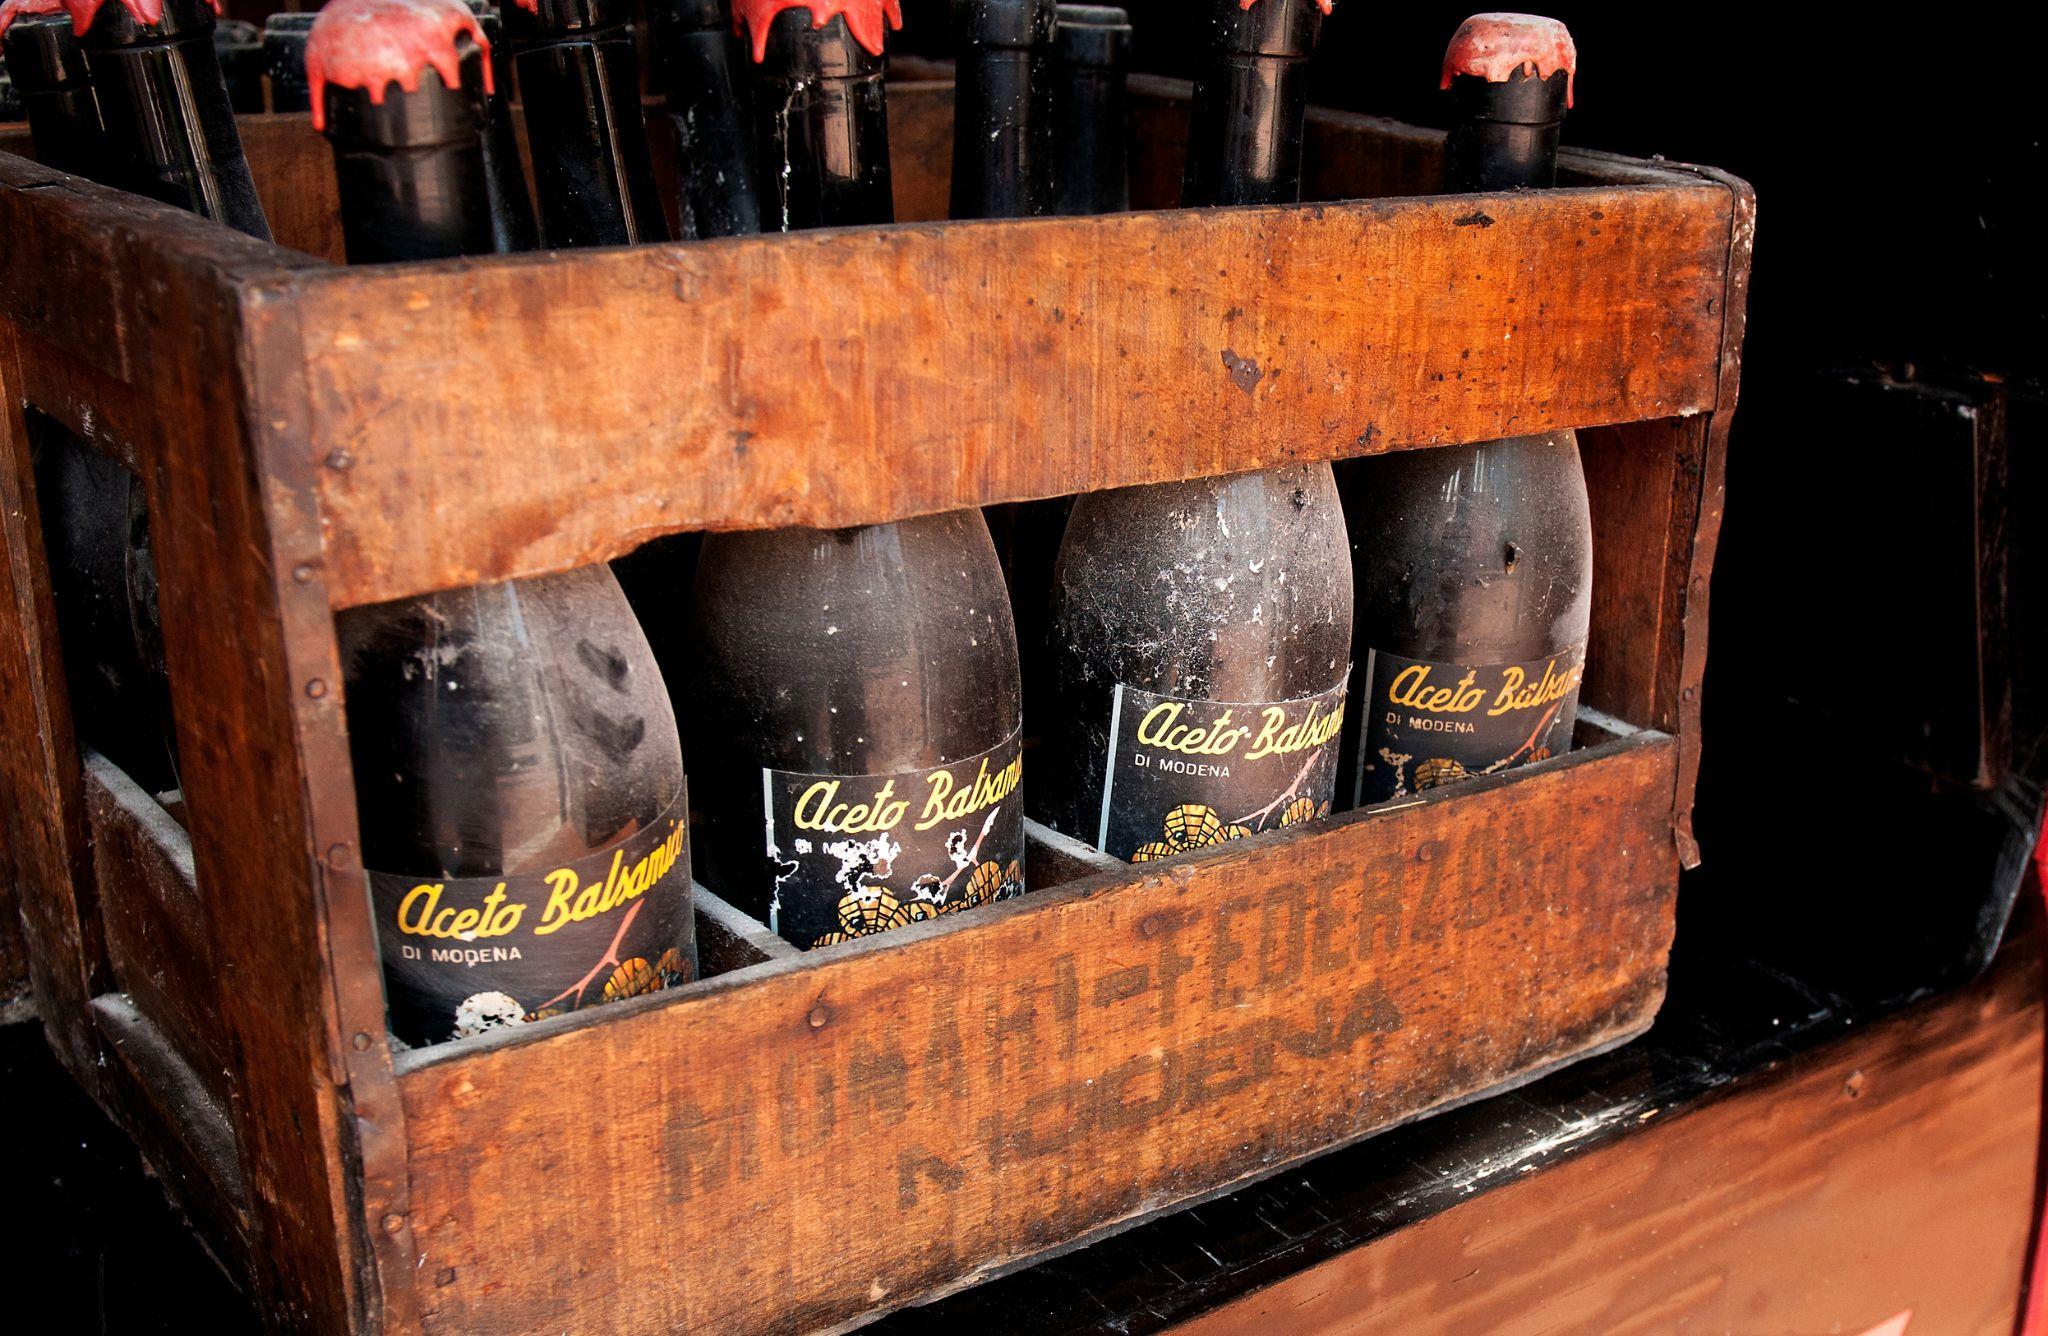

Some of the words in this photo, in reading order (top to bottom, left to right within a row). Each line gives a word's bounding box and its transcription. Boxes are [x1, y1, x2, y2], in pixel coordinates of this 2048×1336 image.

[1388, 664, 1487, 713] Aceto
[1137, 702, 1249, 755] Aceto
[1386, 712, 1401, 726] DI
[1408, 716, 1476, 734] MODENA
[1134, 753, 1150, 767] DI
[1159, 758, 1231, 778] MODENA
[794, 779, 911, 834] Aceto
[397, 882, 527, 941] Aceto
[402, 945, 421, 961] DI
[432, 946, 523, 966] MODENA
